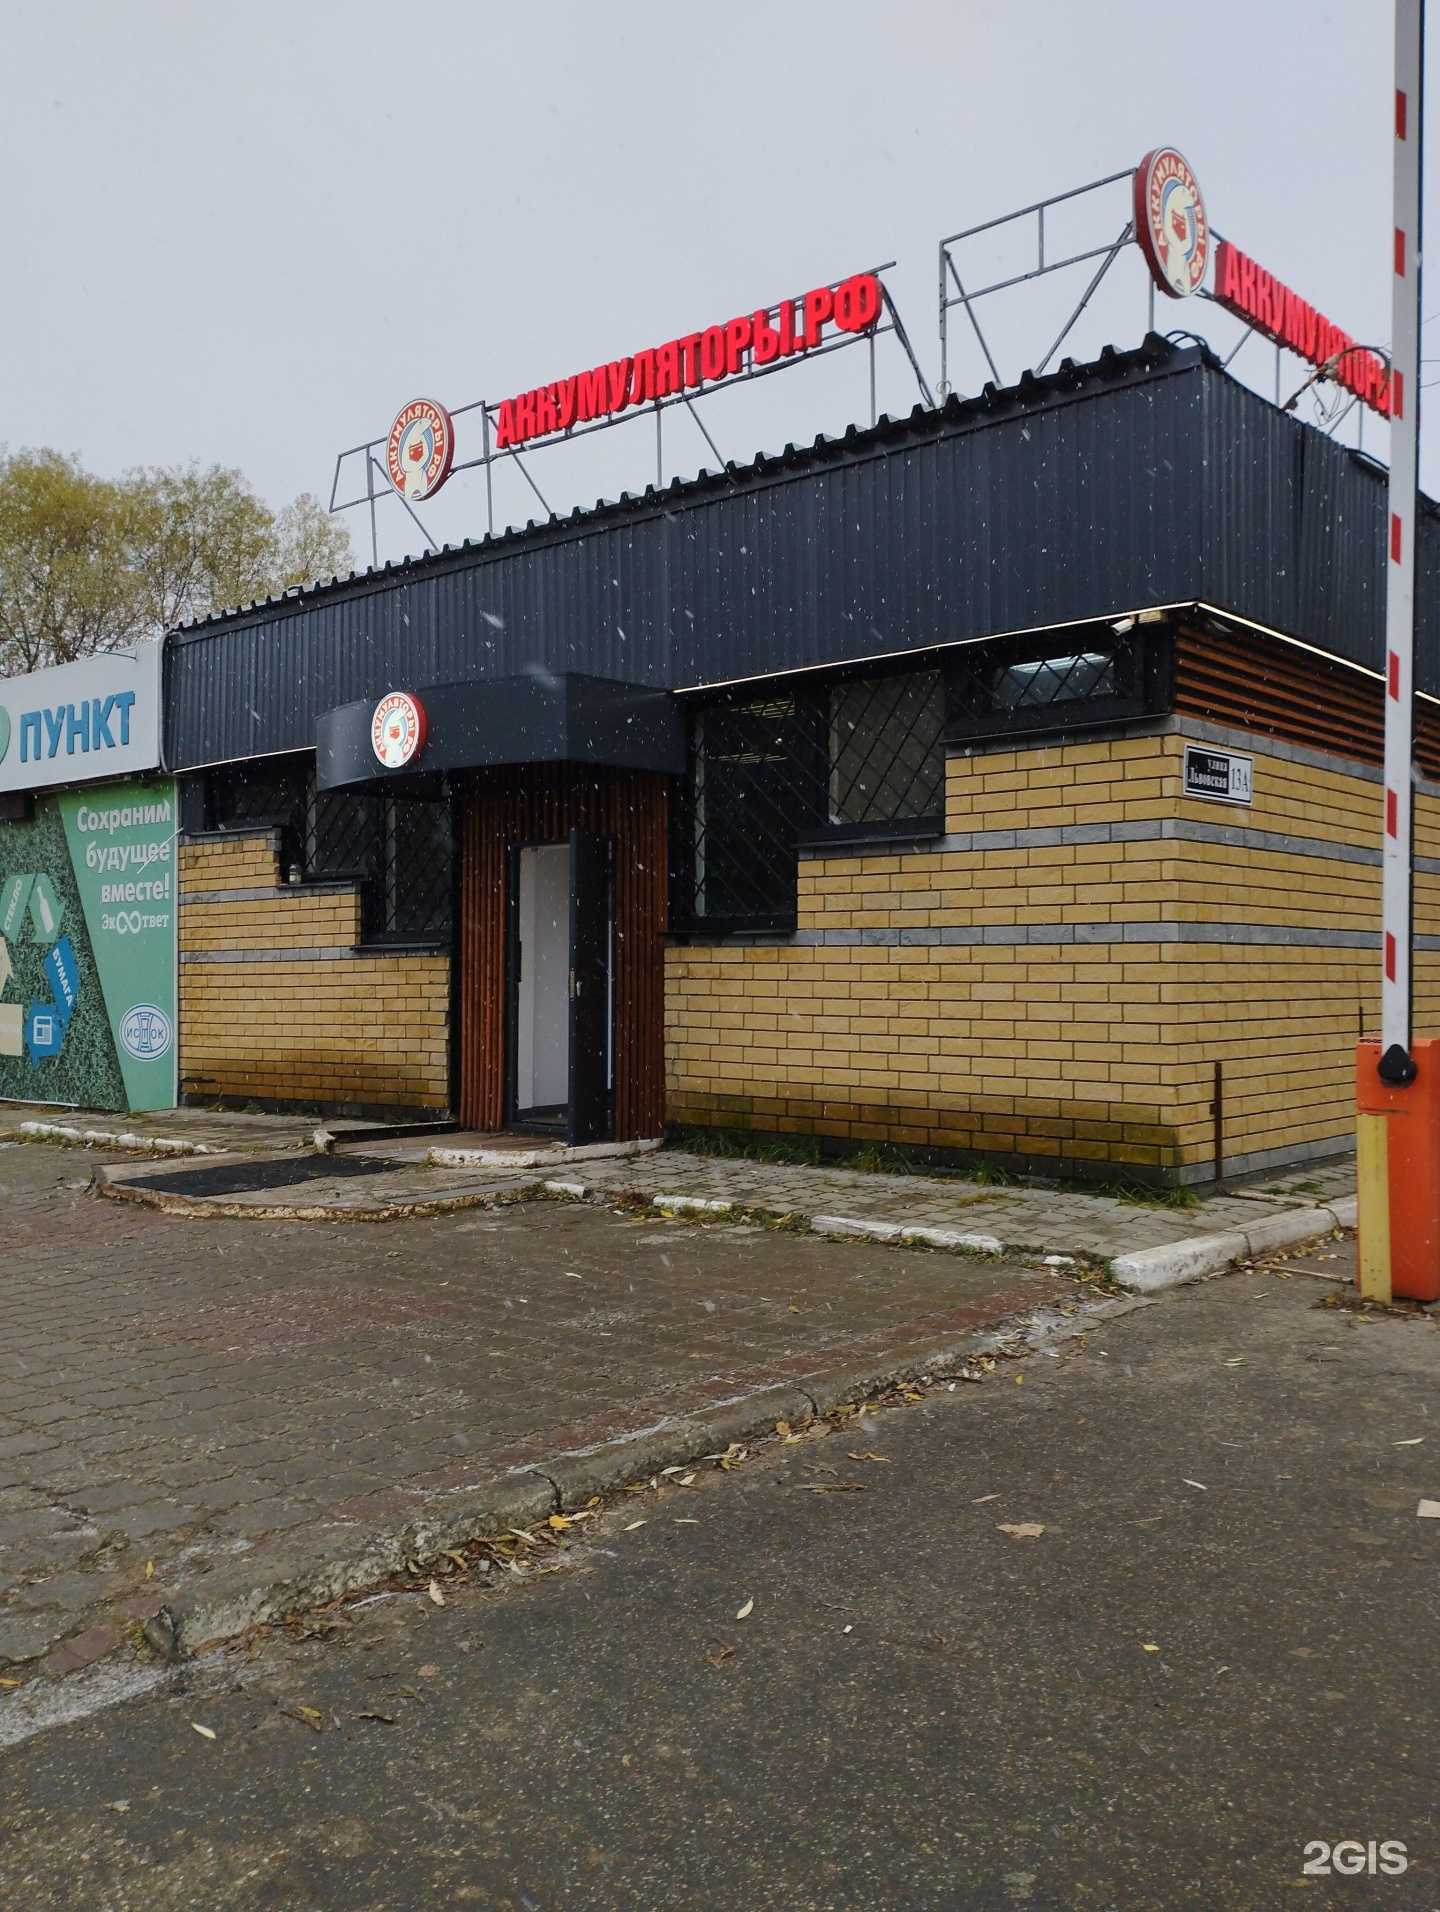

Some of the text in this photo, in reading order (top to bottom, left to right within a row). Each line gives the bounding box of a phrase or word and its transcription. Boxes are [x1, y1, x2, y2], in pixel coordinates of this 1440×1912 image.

[496, 273, 882, 449] АККУМУЛЯТОРЫ.РФ
[388, 405, 443, 482] АККУМУЛЯТОРЫ РФ
[20, 691, 136, 763] ПУНКТ
[77, 801, 171, 834] Сохраним
[86, 841, 170, 874] будущее
[101, 873, 170, 903] вместе!
[126, 1028, 164, 1040] ИСТОК
